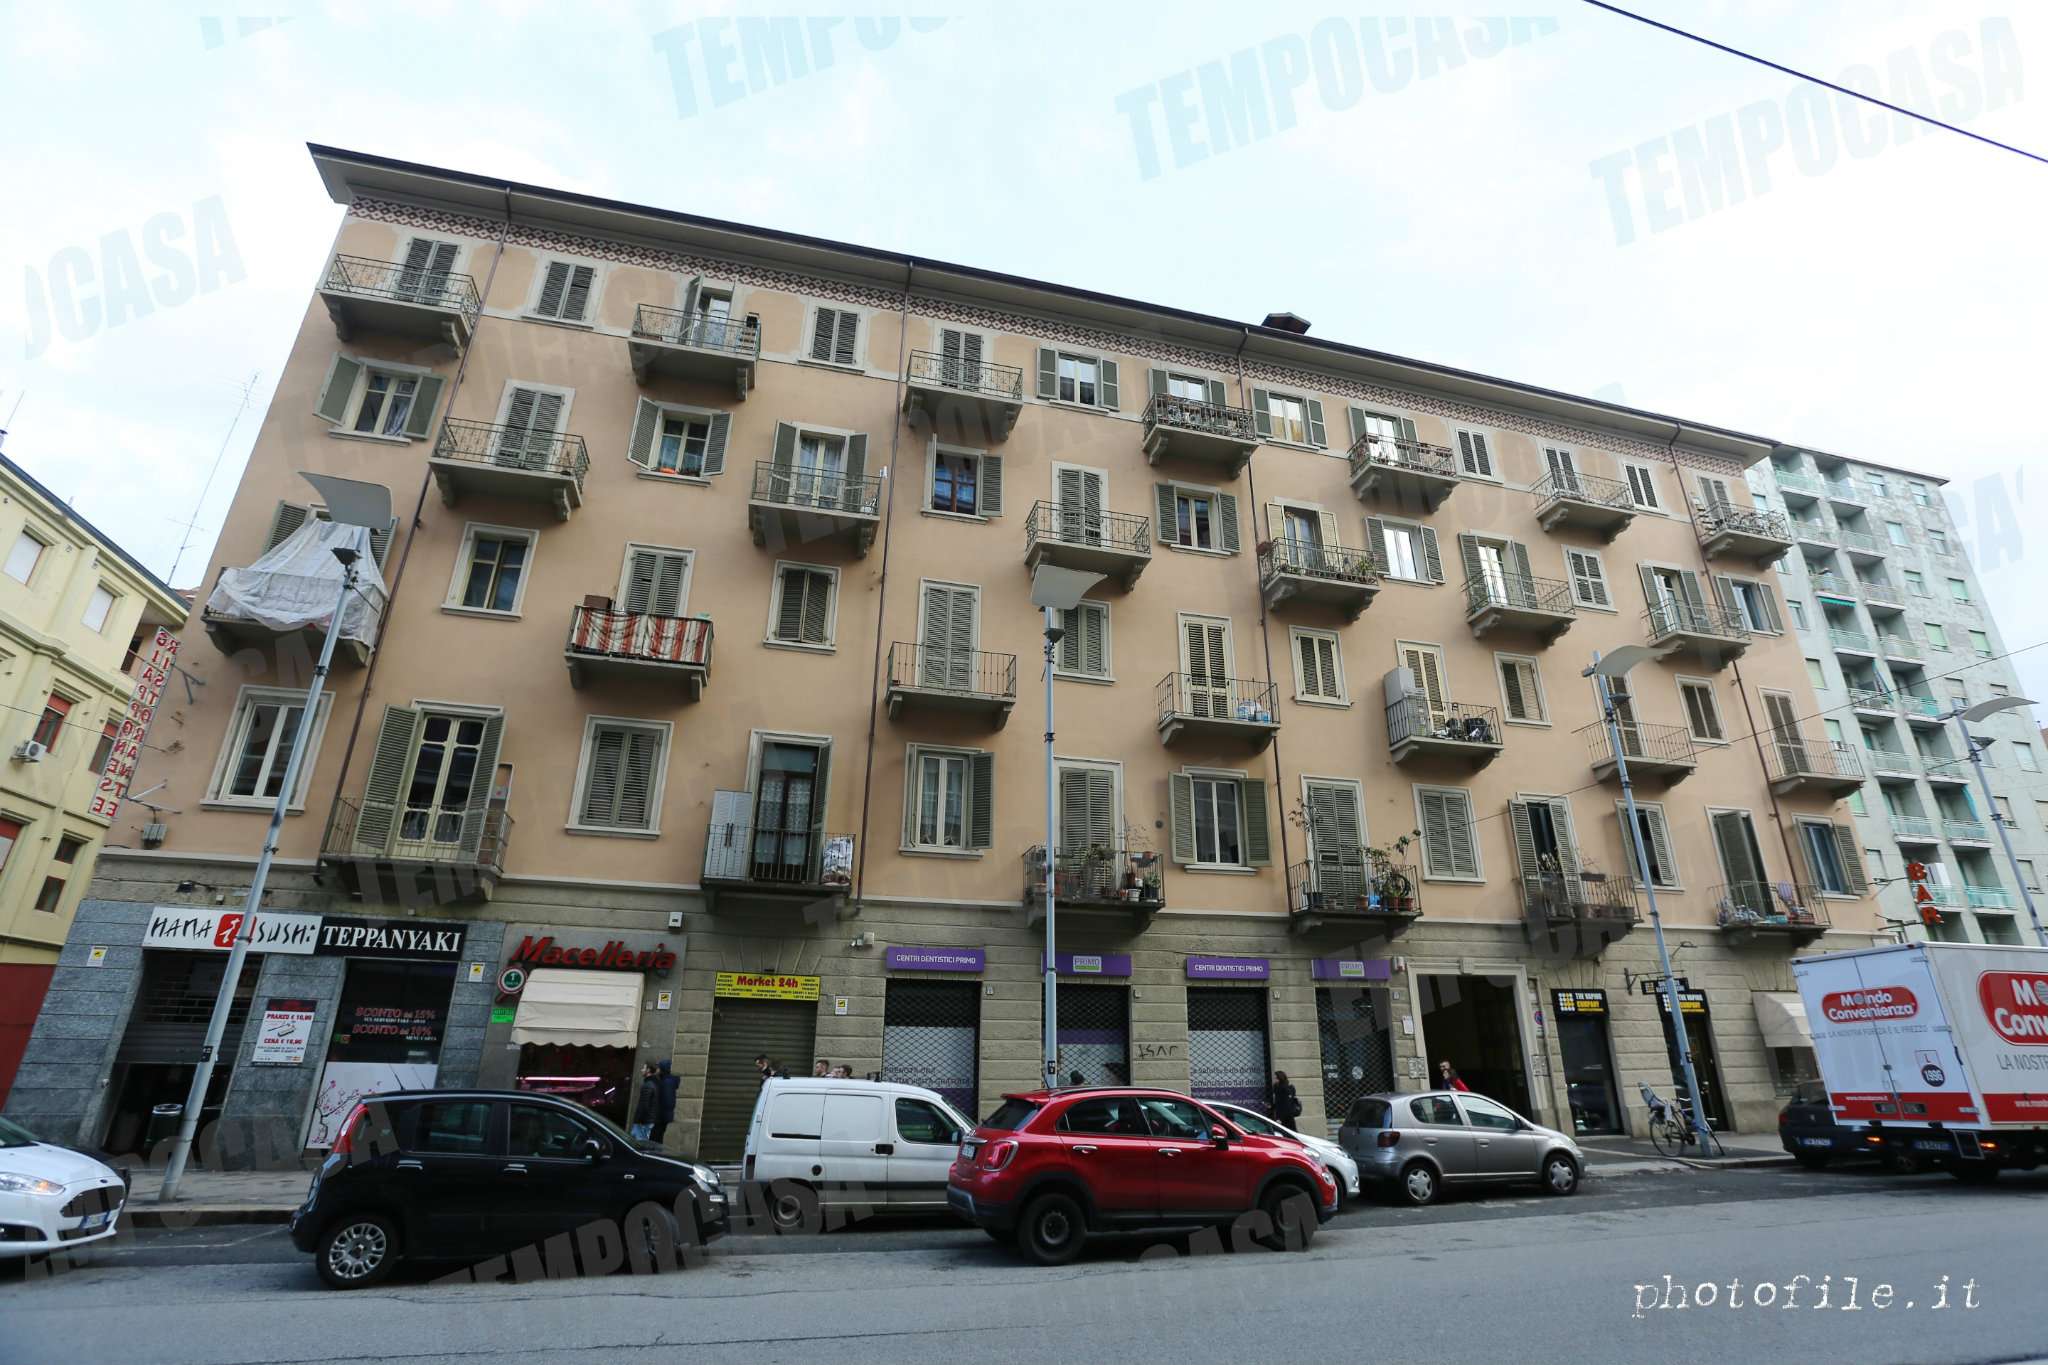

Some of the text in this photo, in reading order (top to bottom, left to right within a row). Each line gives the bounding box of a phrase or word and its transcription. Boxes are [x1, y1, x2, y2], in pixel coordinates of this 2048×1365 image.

[1906, 862, 1944, 925] BAR
[150, 916, 213, 940] HAMA
[322, 925, 462, 952] TEPPANYAKI
[511, 935, 677, 970] Macelleria
[896, 954, 920, 962] CENTRI
[920, 955, 955, 963] DENTISTICI
[1245, 965, 1264, 973] PRIMO
[736, 975, 775, 987] Market
[778, 977, 798, 988] 24h
[355, 1007, 401, 1018] SCONTO
[1828, 1003, 1914, 1021] Convenienza
[352, 1024, 400, 1035] SCONTO
[1995, 1054, 2014, 1070] LA
